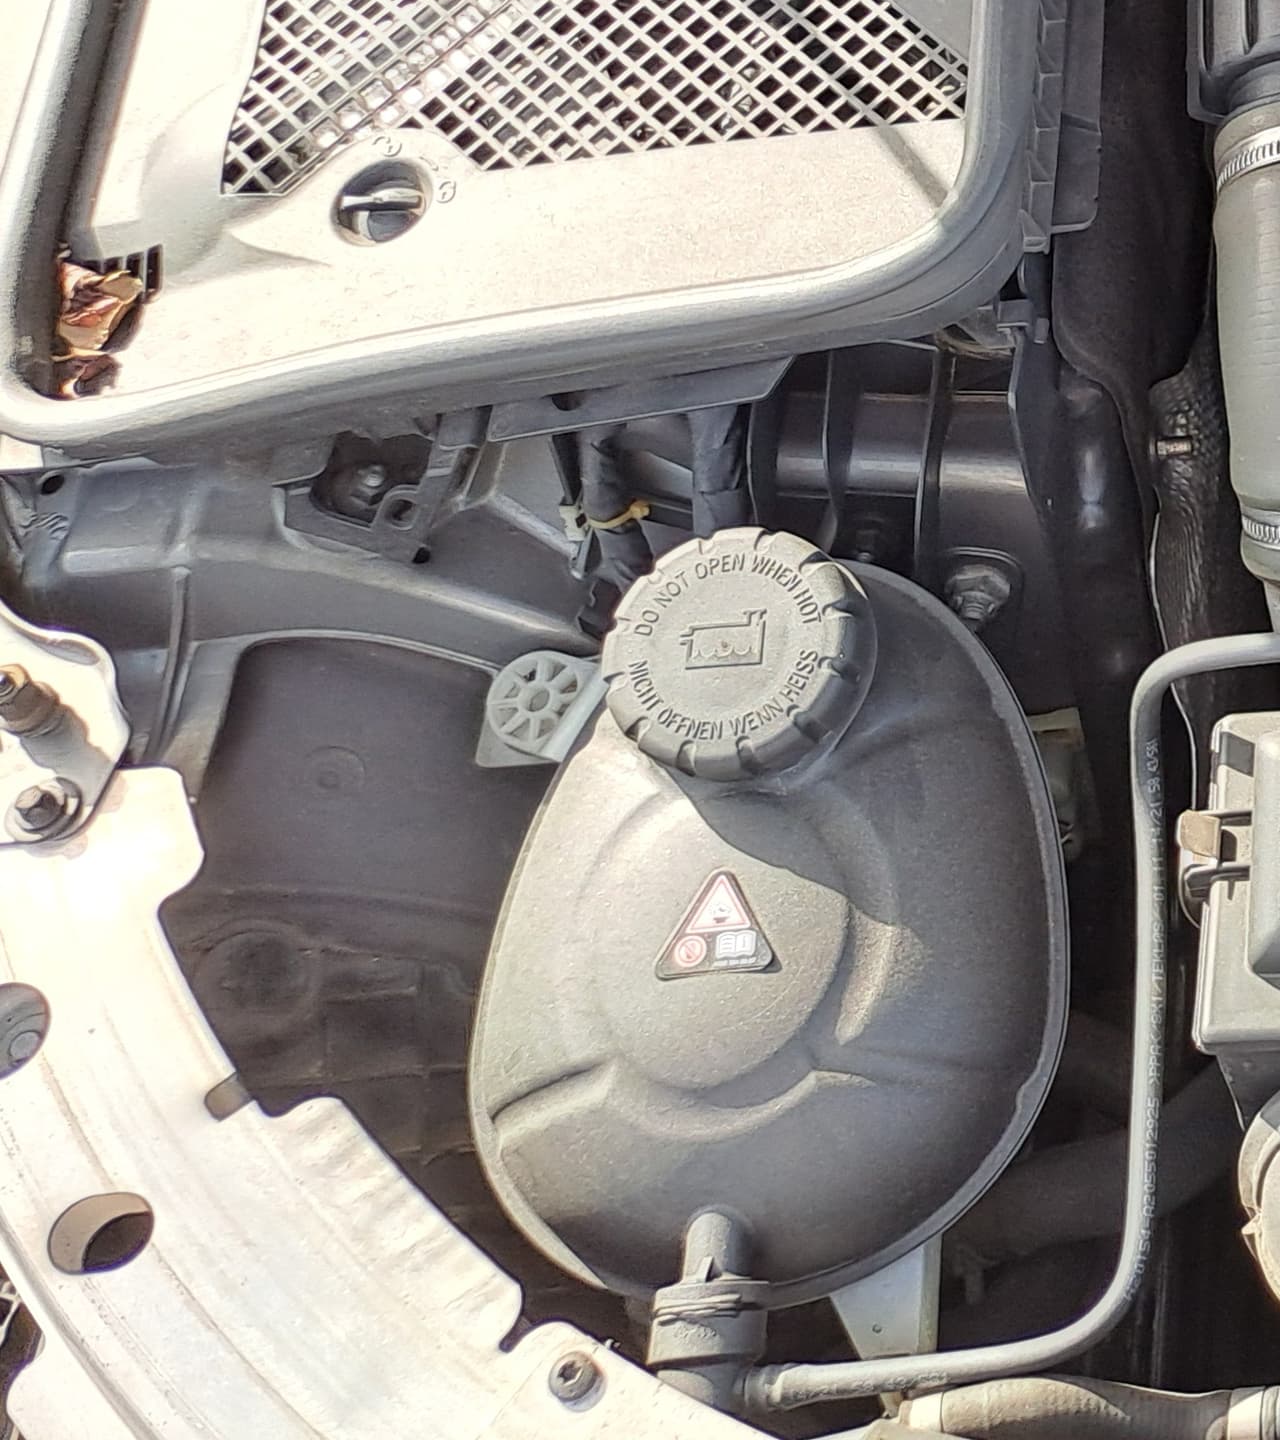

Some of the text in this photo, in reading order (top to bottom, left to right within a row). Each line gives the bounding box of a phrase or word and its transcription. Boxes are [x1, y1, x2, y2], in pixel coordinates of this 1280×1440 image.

[634, 553, 823, 637] DO NOT OPEN WHEN HOT
[628, 659, 665, 712] NICHT
[729, 697, 785, 737] WENN
[779, 648, 819, 704] HEISS
